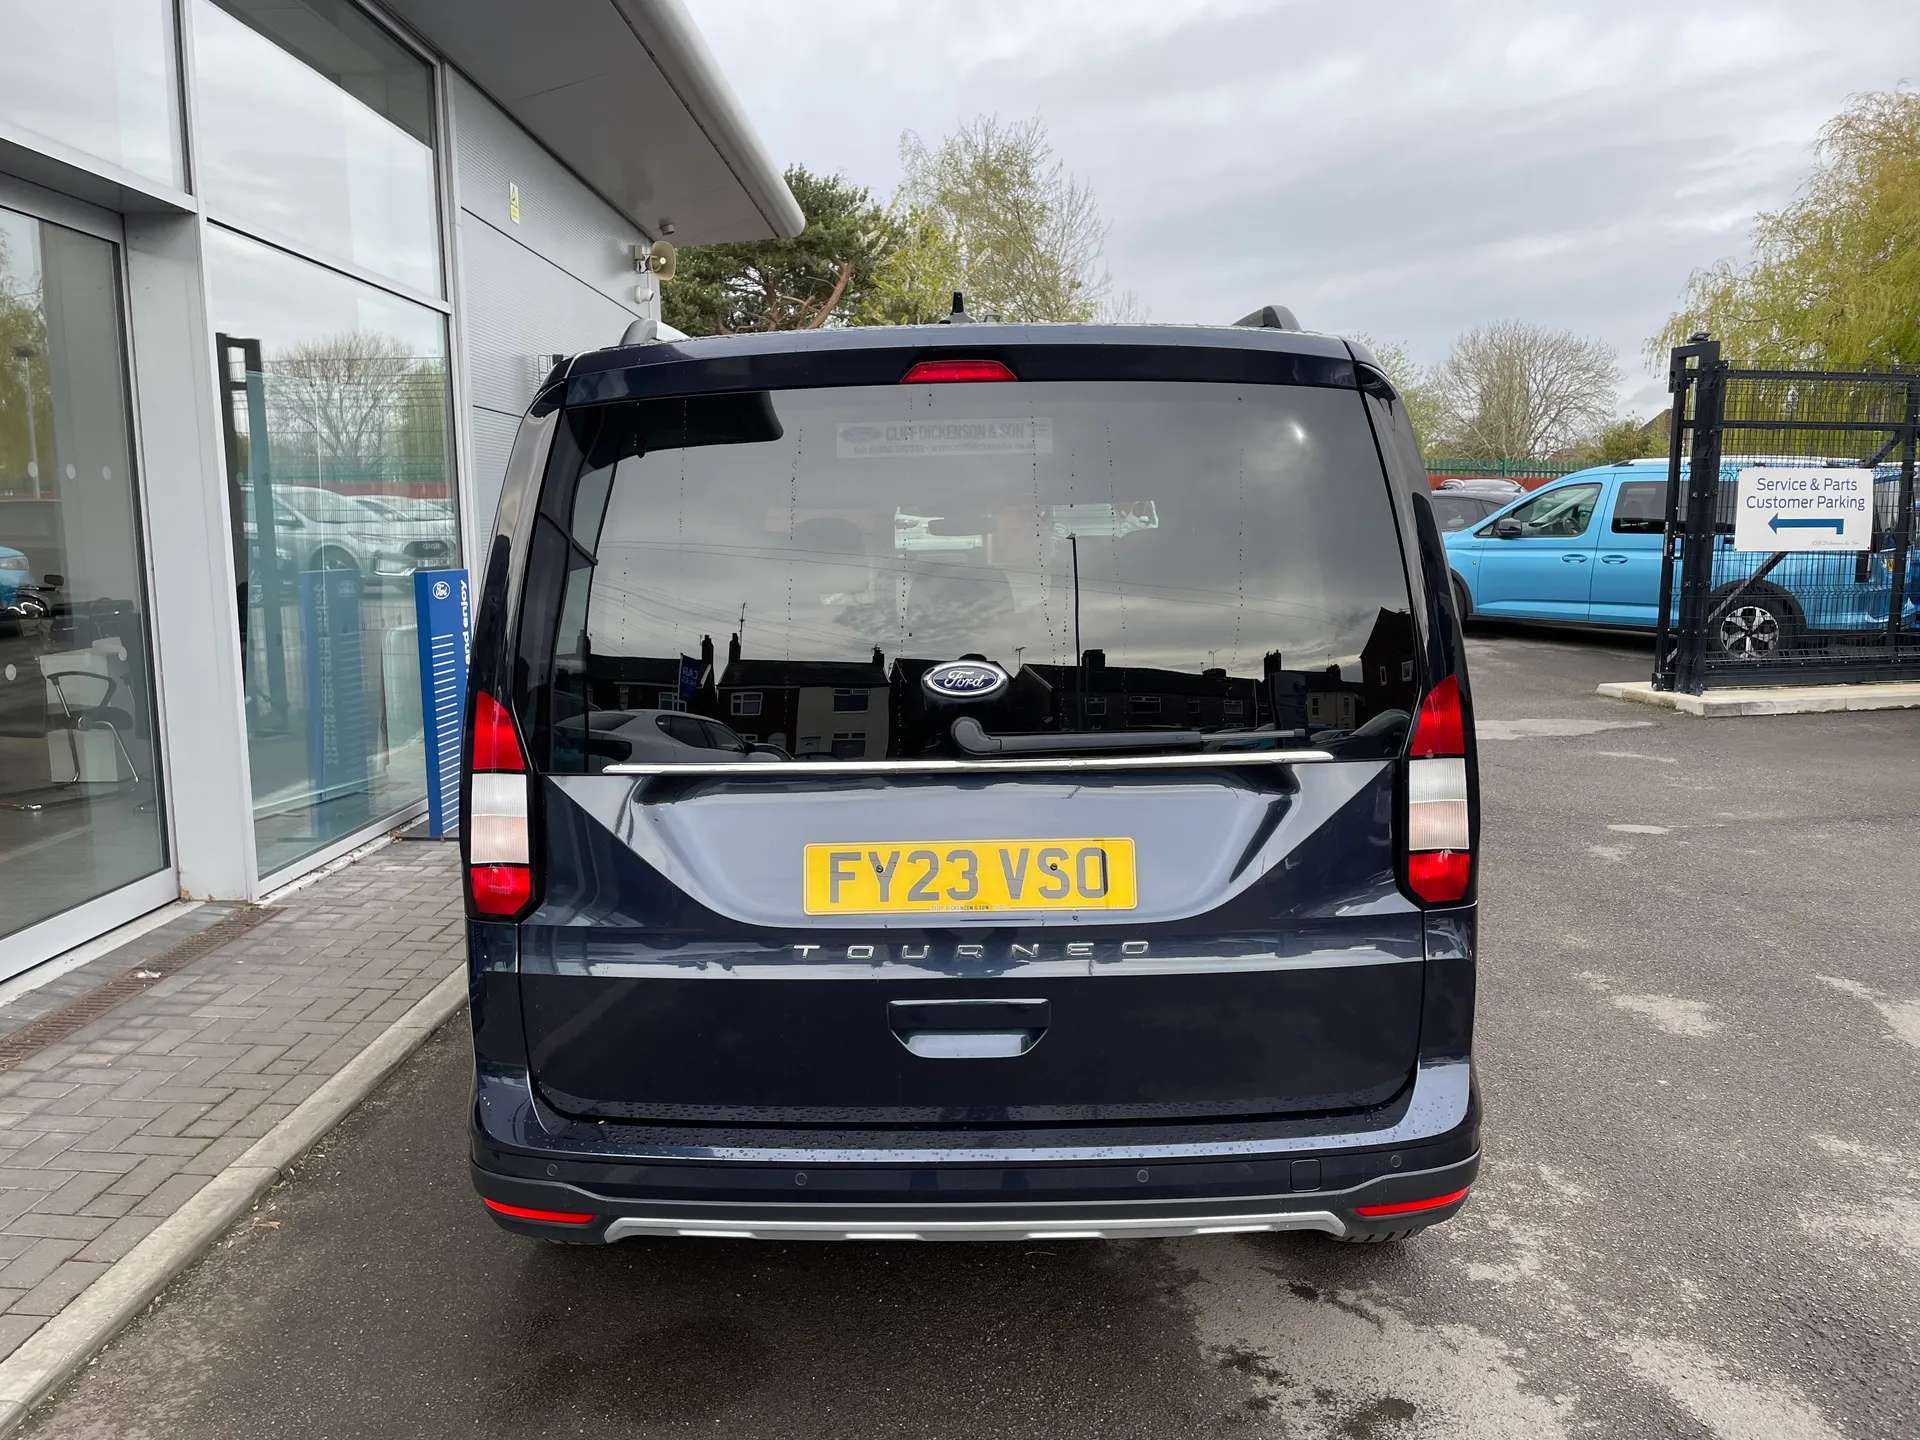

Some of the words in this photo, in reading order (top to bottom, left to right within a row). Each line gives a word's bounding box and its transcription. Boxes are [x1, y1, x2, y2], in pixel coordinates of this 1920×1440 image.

[1001, 422, 1025, 439] SON
[1756, 477, 1807, 491] Service
[1810, 477, 1820, 491] &
[1824, 478, 1857, 491] Parts
[1746, 495, 1813, 509] Customer
[1817, 495, 1865, 511] Parking
[460, 579, 469, 628] enjoy
[462, 631, 471, 666] and
[943, 670, 985, 688] Ford
[829, 850, 979, 904] FY23
[998, 847, 1109, 901] VSO
[793, 941, 1150, 960] TOURNEO
